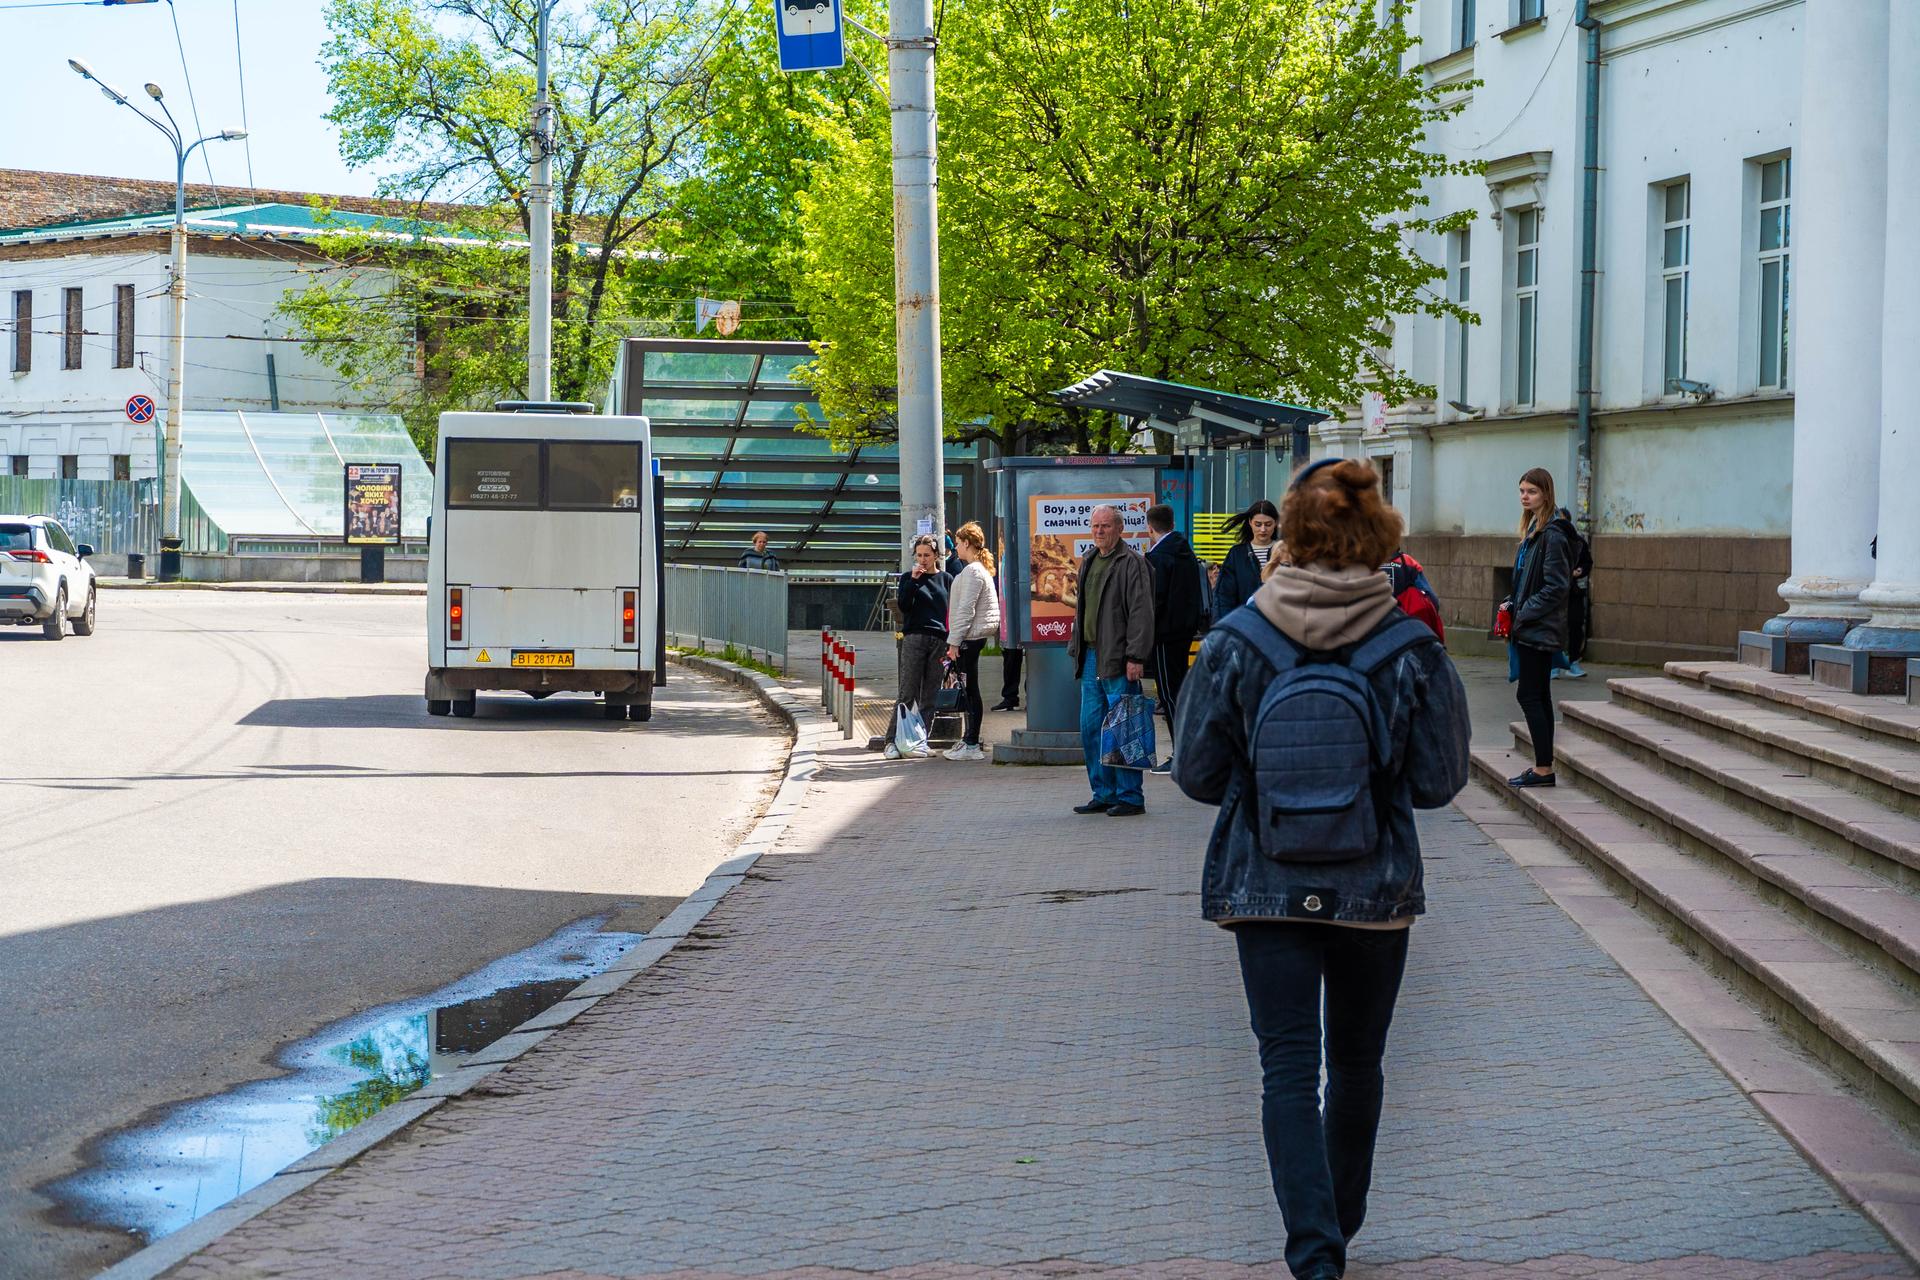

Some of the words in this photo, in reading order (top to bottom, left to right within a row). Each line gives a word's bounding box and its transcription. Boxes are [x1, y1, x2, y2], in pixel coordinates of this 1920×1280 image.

[355, 484, 393, 492] ЧОЛОВІКИ
[360, 497, 389, 505] ХОЧУТЬ
[616, 497, 635, 508] 49
[1043, 504, 1068, 516] Воу,
[1044, 517, 1082, 527] смачні
[534, 654, 556, 665] 2817
[557, 655, 571, 665] AA
